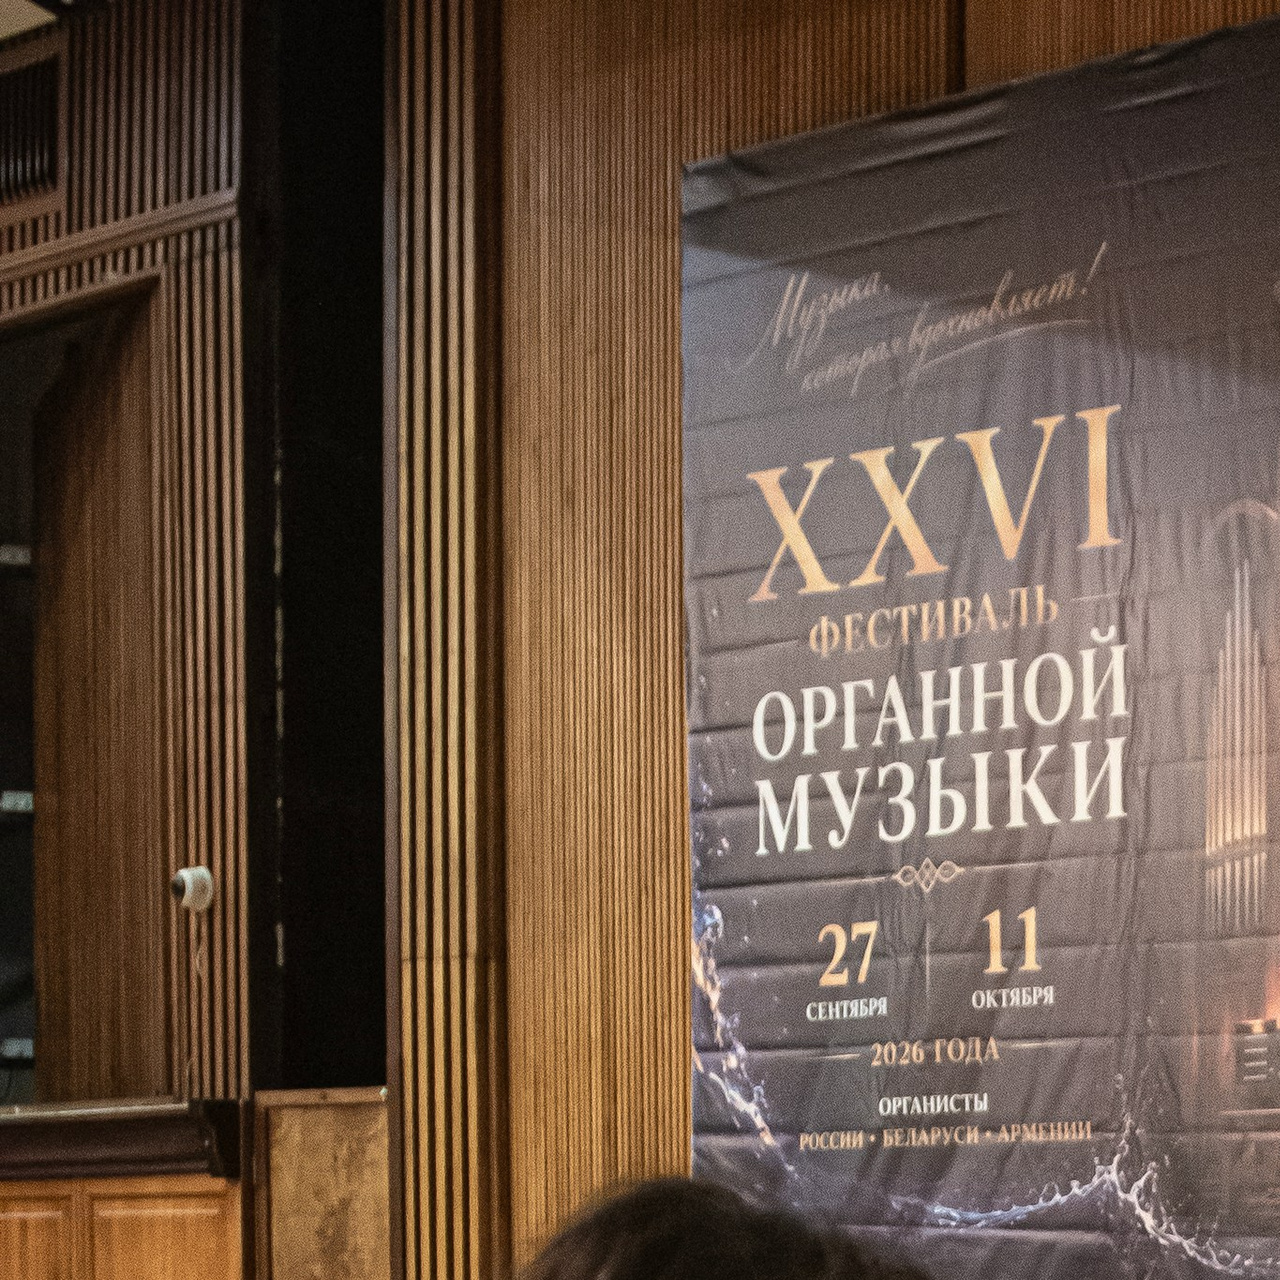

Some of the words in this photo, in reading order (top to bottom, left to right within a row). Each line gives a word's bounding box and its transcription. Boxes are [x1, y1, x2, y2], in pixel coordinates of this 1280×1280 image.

[747, 404, 1122, 603] XXVI
[808, 584, 1060, 658] ФЕСТИВАЛЬ
[752, 625, 1129, 762] ОРГАННОЙ
[755, 736, 1128, 857] МУЗЫКИ
[818, 920, 879, 988] 27
[982, 906, 1042, 975] 11
[806, 997, 888, 1022] СЕНТЯБРЯ
[972, 985, 1055, 1010] ОКТЯБРЯ
[870, 1041, 926, 1067] 2026
[931, 1036, 1001, 1066] ГОДА
[799, 1131, 865, 1151] РОССИИ
[883, 1123, 980, 1148] БЕЛАРУСИ
[998, 1120, 1092, 1143] АРМЕНИИ
[878, 1092, 989, 1117] ОРГАНИСТЫ
